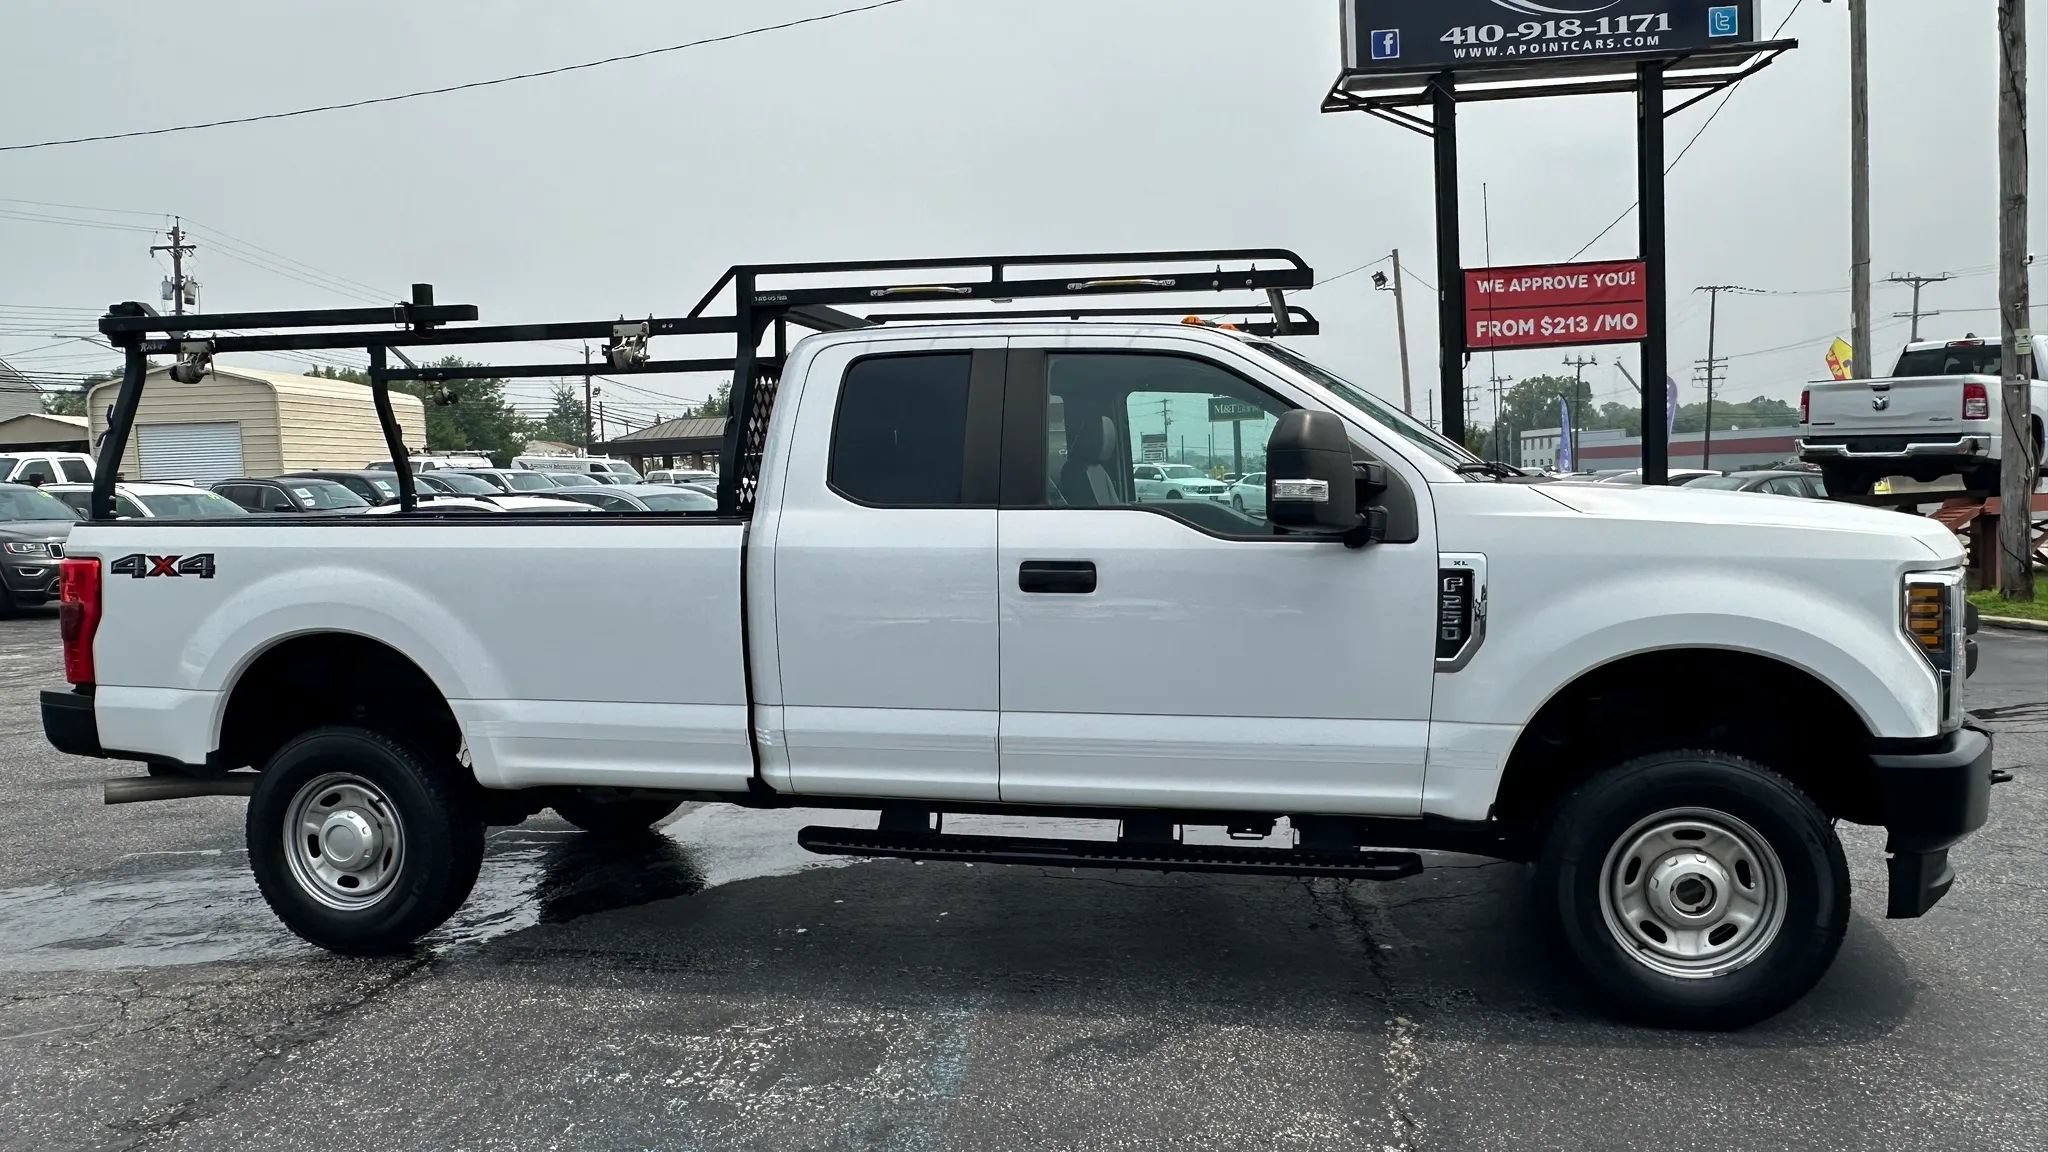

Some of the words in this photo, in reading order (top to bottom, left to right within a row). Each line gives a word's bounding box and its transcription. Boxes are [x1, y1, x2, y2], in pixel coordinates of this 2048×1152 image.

[1440, 13, 1672, 45] 410-918-1171
[1453, 36, 1660, 59] WWW.APOINTCARS.COM
[1476, 279, 1505, 293] WE
[1509, 274, 1589, 293] APPROVE
[1593, 270, 1637, 288] YOU!
[1476, 318, 1534, 338] FROM
[1540, 315, 1589, 336] $213
[1593, 312, 1638, 333] /MO
[1214, 404, 1237, 414] M&T
[1441, 577, 1464, 641] F250
